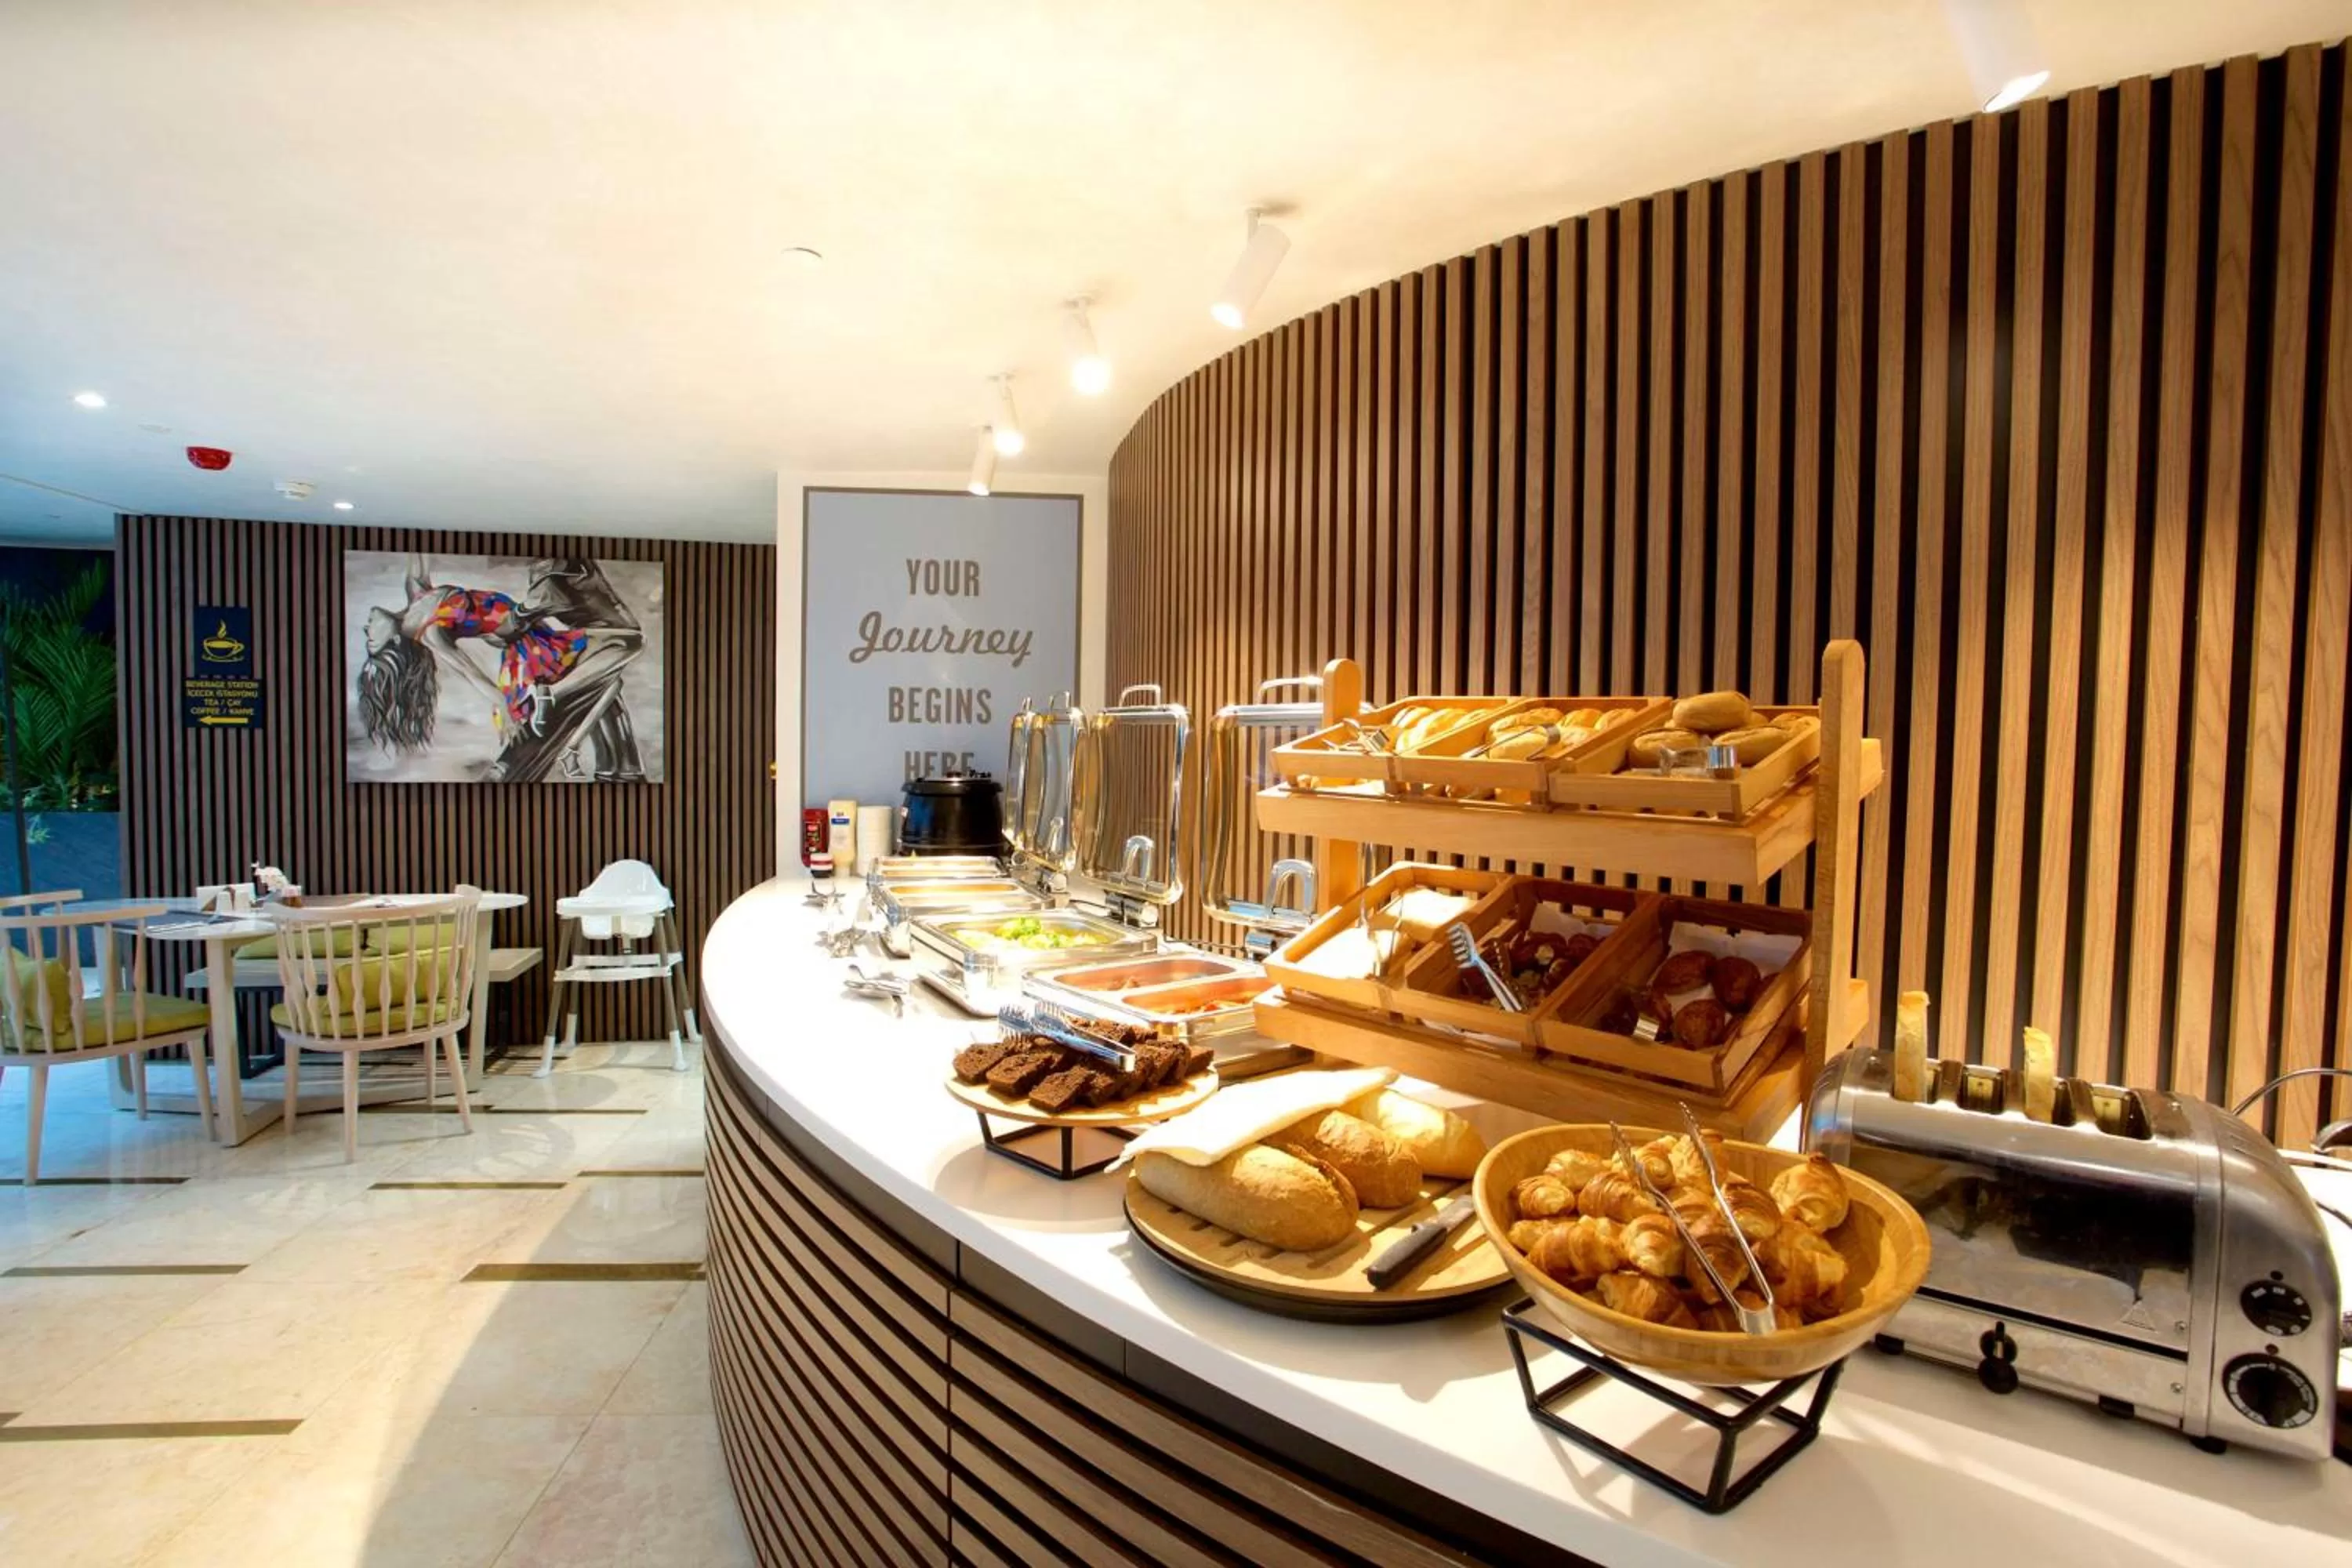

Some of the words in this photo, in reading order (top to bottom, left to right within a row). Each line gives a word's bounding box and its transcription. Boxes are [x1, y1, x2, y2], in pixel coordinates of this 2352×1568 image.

[906, 558, 980, 597] YOUR
[848, 611, 1034, 668] Journey
[888, 686, 992, 724] BEGINS
[905, 750, 975, 782] HERE
